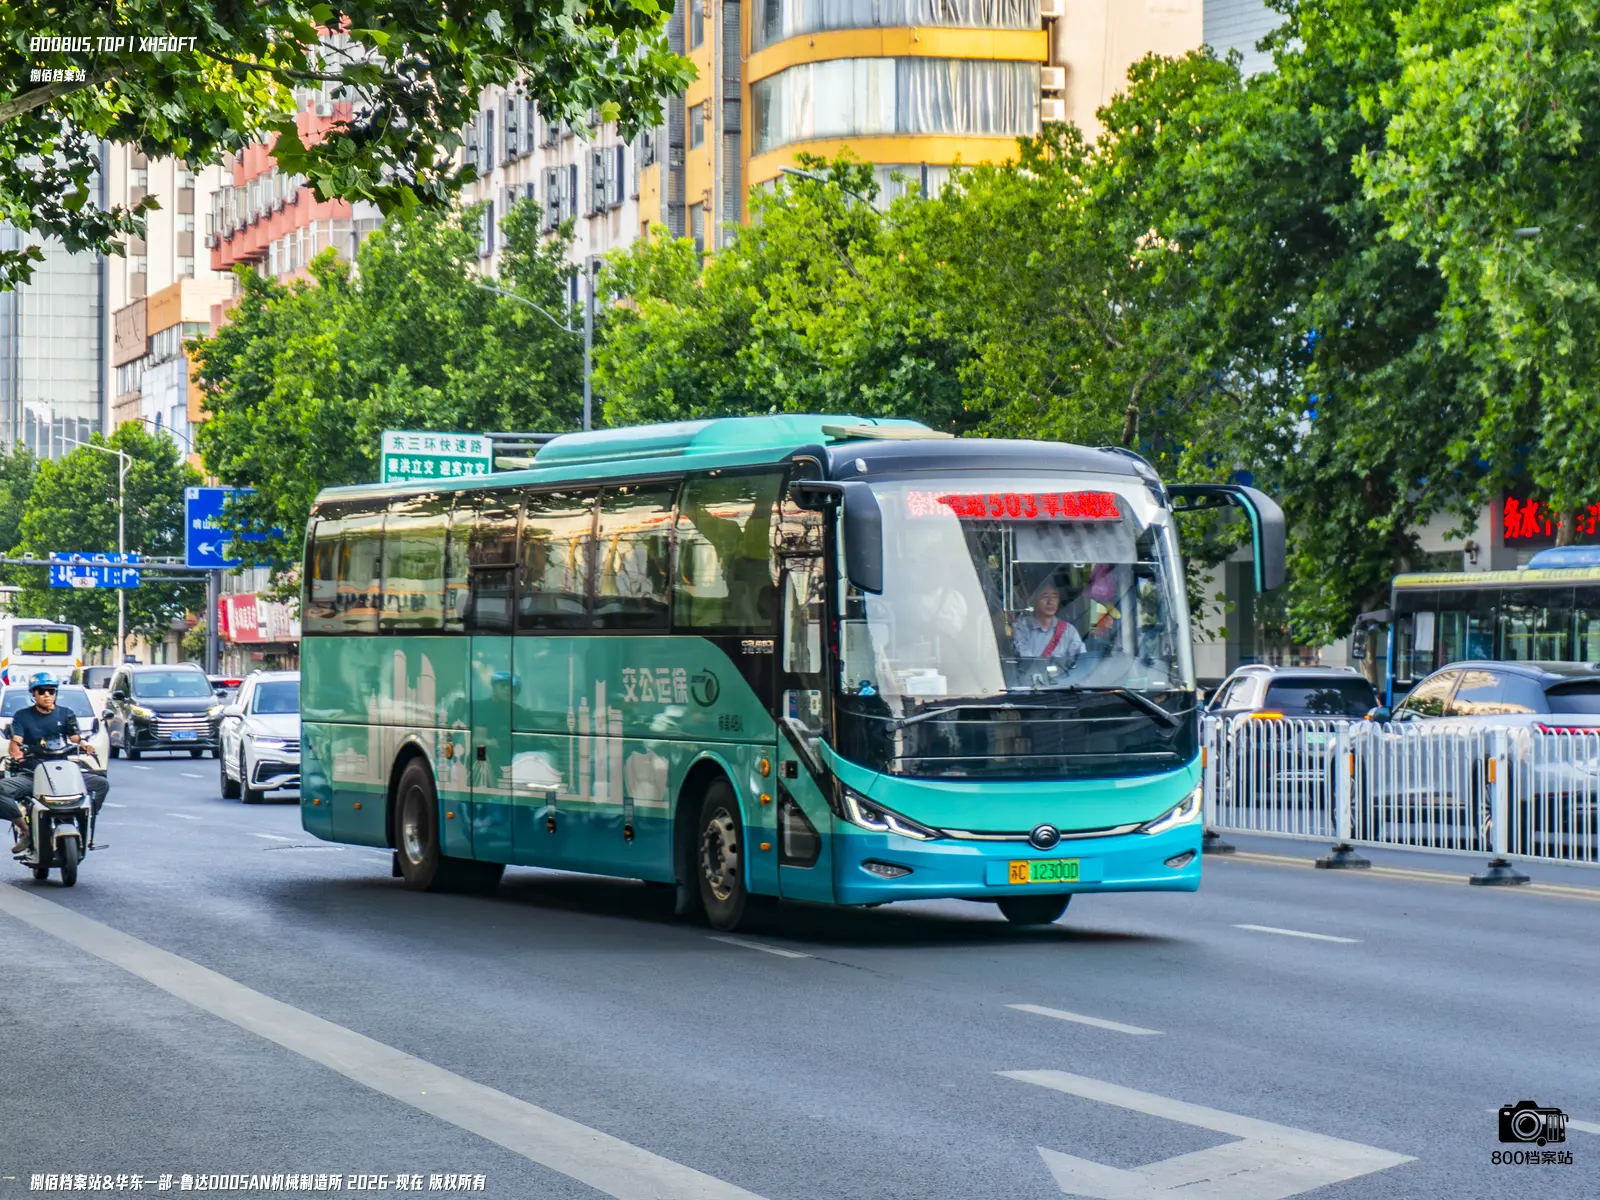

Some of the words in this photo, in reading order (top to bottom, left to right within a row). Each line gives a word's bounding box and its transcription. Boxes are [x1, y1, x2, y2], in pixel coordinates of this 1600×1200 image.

[392, 436, 483, 454] 东三环快速路
